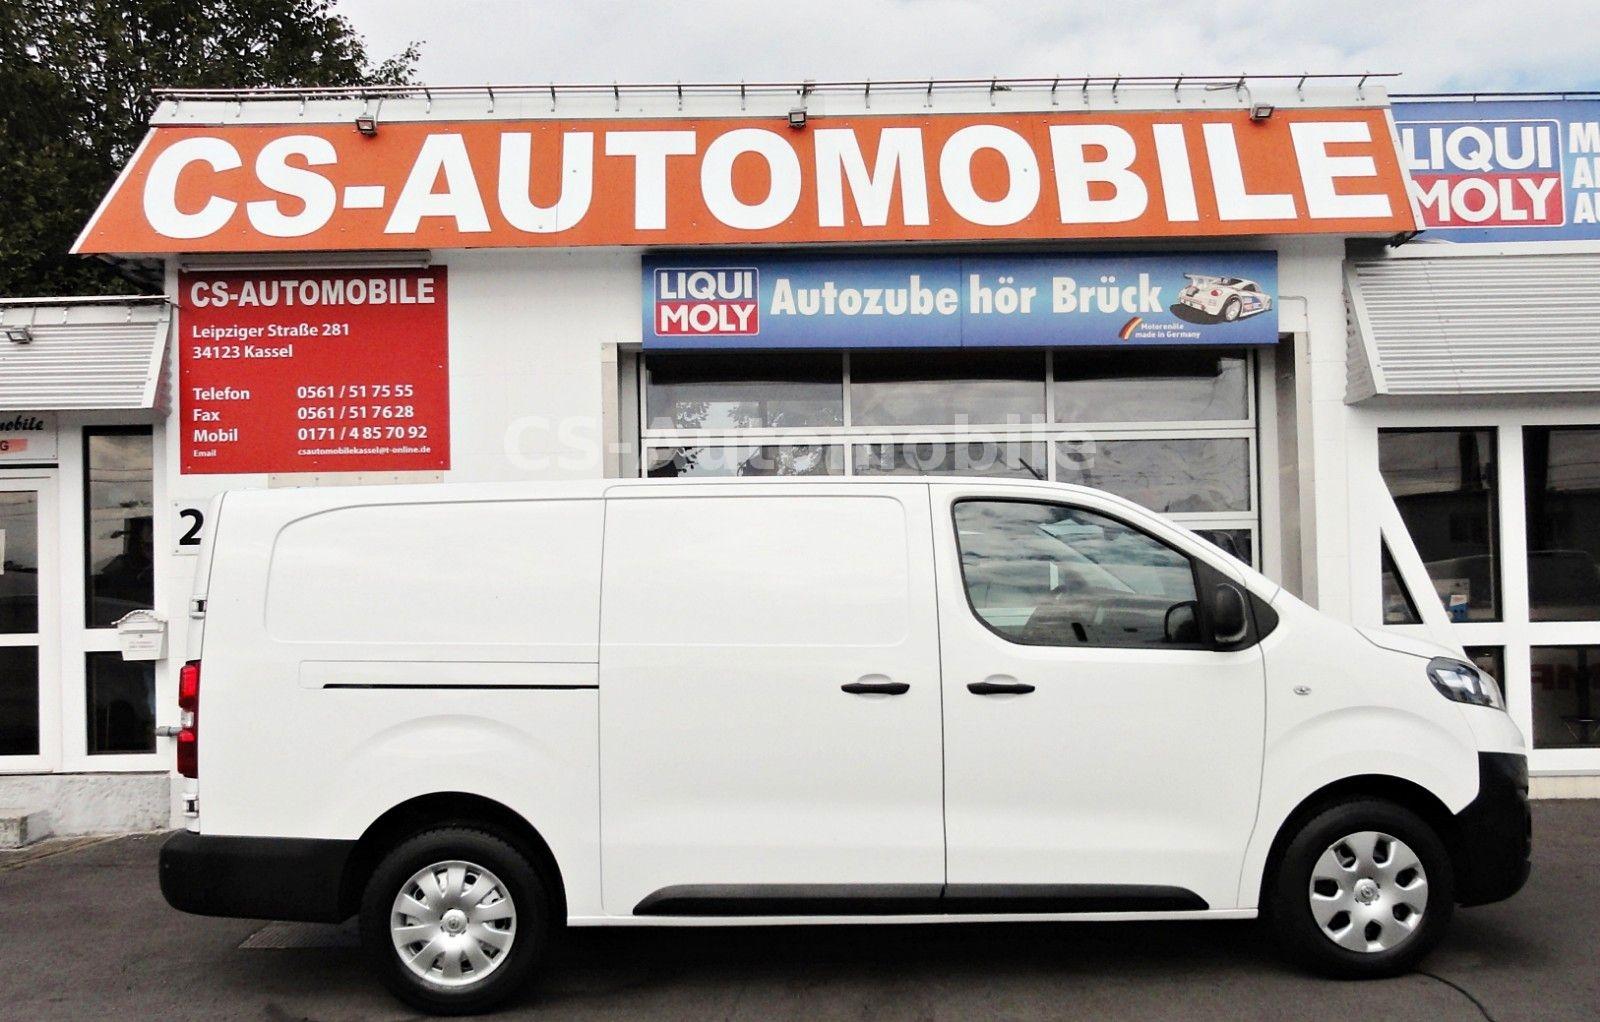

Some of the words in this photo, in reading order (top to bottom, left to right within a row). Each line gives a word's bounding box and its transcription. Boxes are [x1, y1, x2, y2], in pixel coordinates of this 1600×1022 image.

[1400, 126, 1553, 172] LIQUI
[144, 122, 1394, 239] CS-AUTOMOBILE
[1411, 177, 1559, 223] MOLY
[190, 278, 435, 307] CS-AUTOMOBILE
[660, 271, 753, 300] LIQUI
[1052, 272, 1164, 313] Brück
[660, 303, 756, 332] MOLY
[192, 325, 263, 341] Leipziger
[267, 323, 318, 337] Straße
[322, 323, 350, 336] 281
[1135, 331, 1156, 339] made
[1166, 330, 1201, 339] Germany
[192, 345, 241, 359] 34123
[244, 344, 293, 358] Kassel
[193, 386, 250, 400] Telefon
[297, 386, 335, 399] 0561
[339, 385, 346, 398] /
[349, 385, 366, 398] 51
[372, 384, 391, 397] 75
[394, 384, 413, 397] 55
[193, 408, 220, 421] Fax
[297, 406, 335, 419] 0561
[339, 406, 346, 419] /
[349, 406, 366, 419] 51
[193, 428, 238, 442] Mobil
[297, 427, 335, 441] 0171
[340, 427, 347, 440] /
[349, 427, 359, 440] 4
[362, 426, 382, 440] 85
[385, 426, 405, 439] 70
[408, 425, 428, 439] 92
[193, 449, 217, 457] Email
[297, 446, 431, 456] csautomobilekassel@t-online.de
[179, 508, 204, 546] 2
